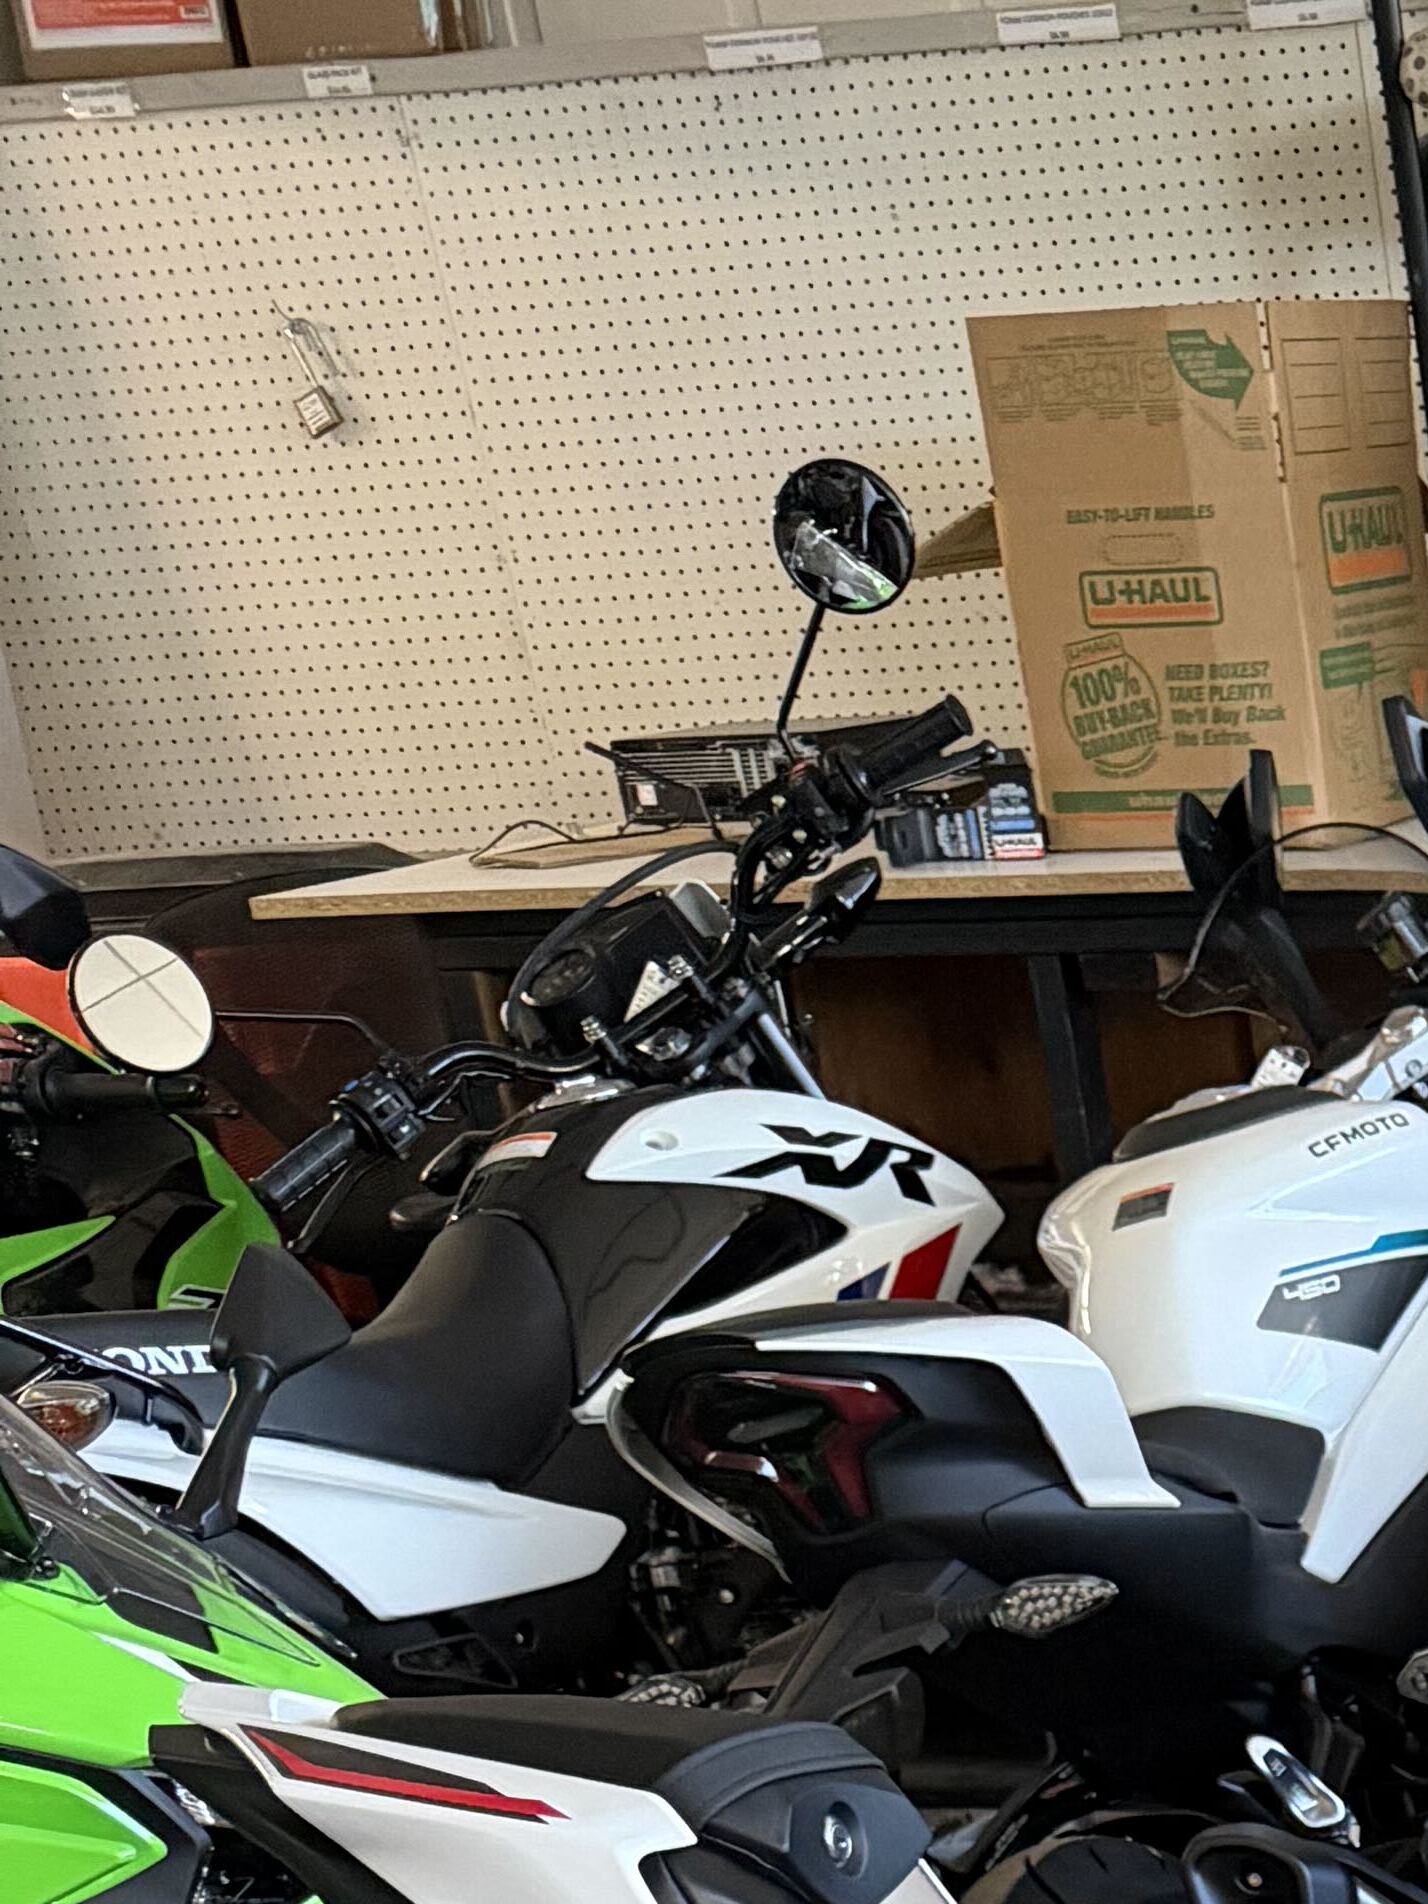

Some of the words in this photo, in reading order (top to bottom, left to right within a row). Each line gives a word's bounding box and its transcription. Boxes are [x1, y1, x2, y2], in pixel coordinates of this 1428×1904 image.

[1088, 576, 1211, 606] U-HAUL
[1165, 663, 1204, 681] NEED
[1209, 661, 1270, 681] BOXES?
[1069, 661, 1142, 710] 100%
[1168, 686, 1205, 703] TAKE
[1209, 683, 1273, 703] PLENTY!
[1211, 708, 1240, 728] Buy
[1246, 704, 1286, 724] Back
[1308, 1112, 1410, 1158] CFMOTO
[1281, 1274, 1342, 1302] 450
